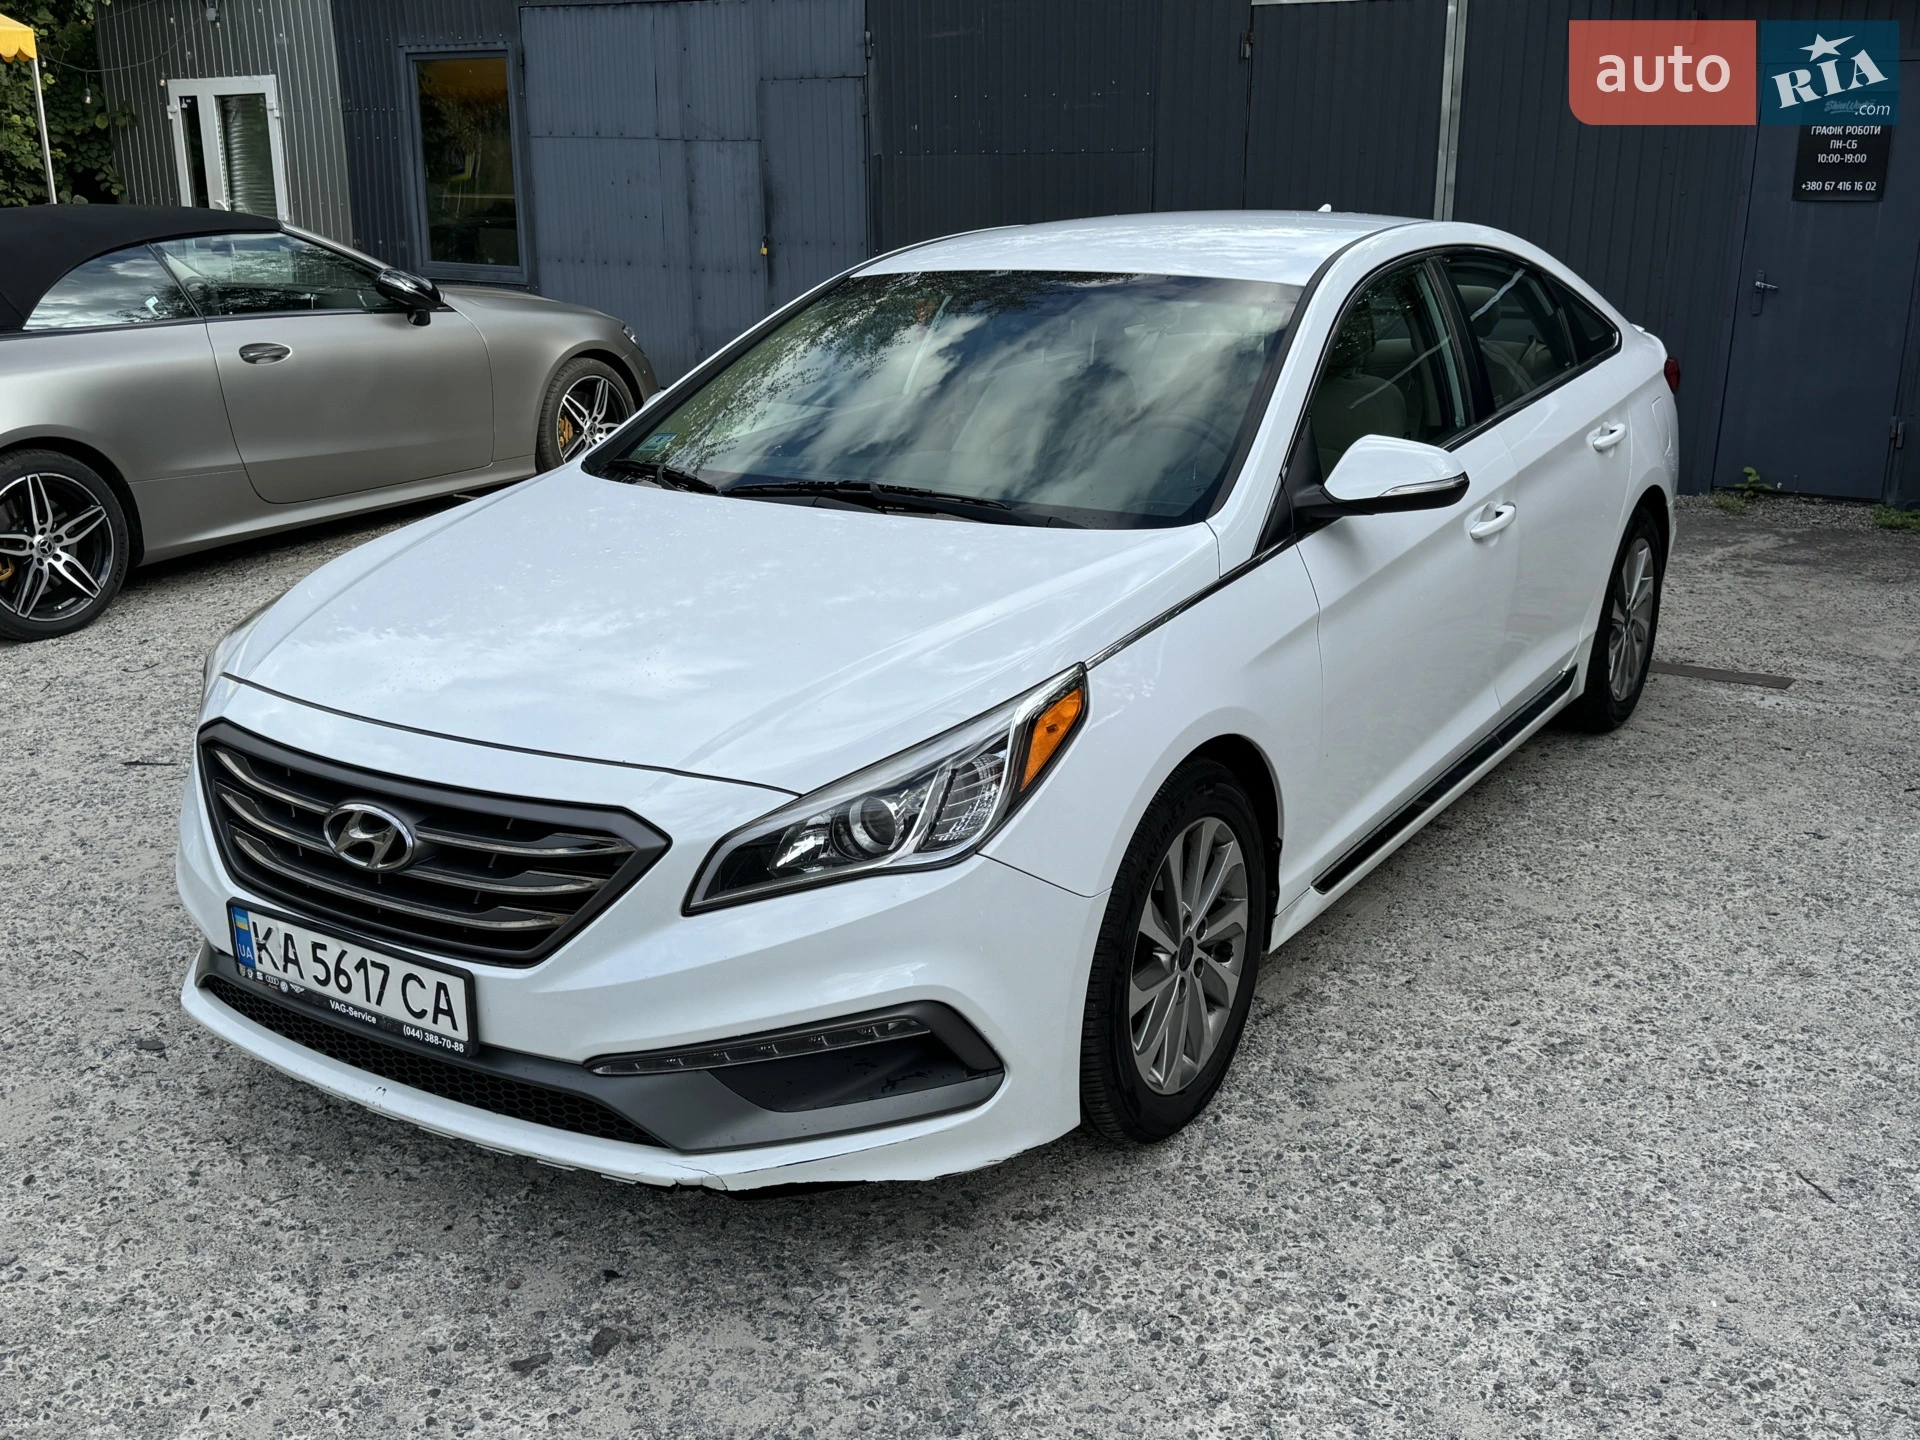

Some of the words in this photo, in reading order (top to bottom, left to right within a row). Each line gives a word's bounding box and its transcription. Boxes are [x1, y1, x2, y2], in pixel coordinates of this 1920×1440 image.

[1811, 125, 1844, 135] ГРАФІК
[1845, 125, 1882, 135] РОБОТИ
[1829, 139, 1858, 149] ПН-СБ
[1817, 153, 1867, 163] 10:00-19:00
[1801, 181, 1823, 191] +380
[1824, 181, 1836, 191] 67
[1837, 181, 1852, 191] 416
[1854, 181, 1863, 191] 16
[1865, 181, 1877, 191] 02
[238, 943, 254, 961] UA
[252, 920, 305, 981] KA
[310, 940, 391, 1007] 5617
[401, 971, 459, 1032] CA
[329, 999, 377, 1025] VAG-Service
[402, 1024, 423, 1041] (044)
[424, 1032, 465, 1053] 388-70-88
